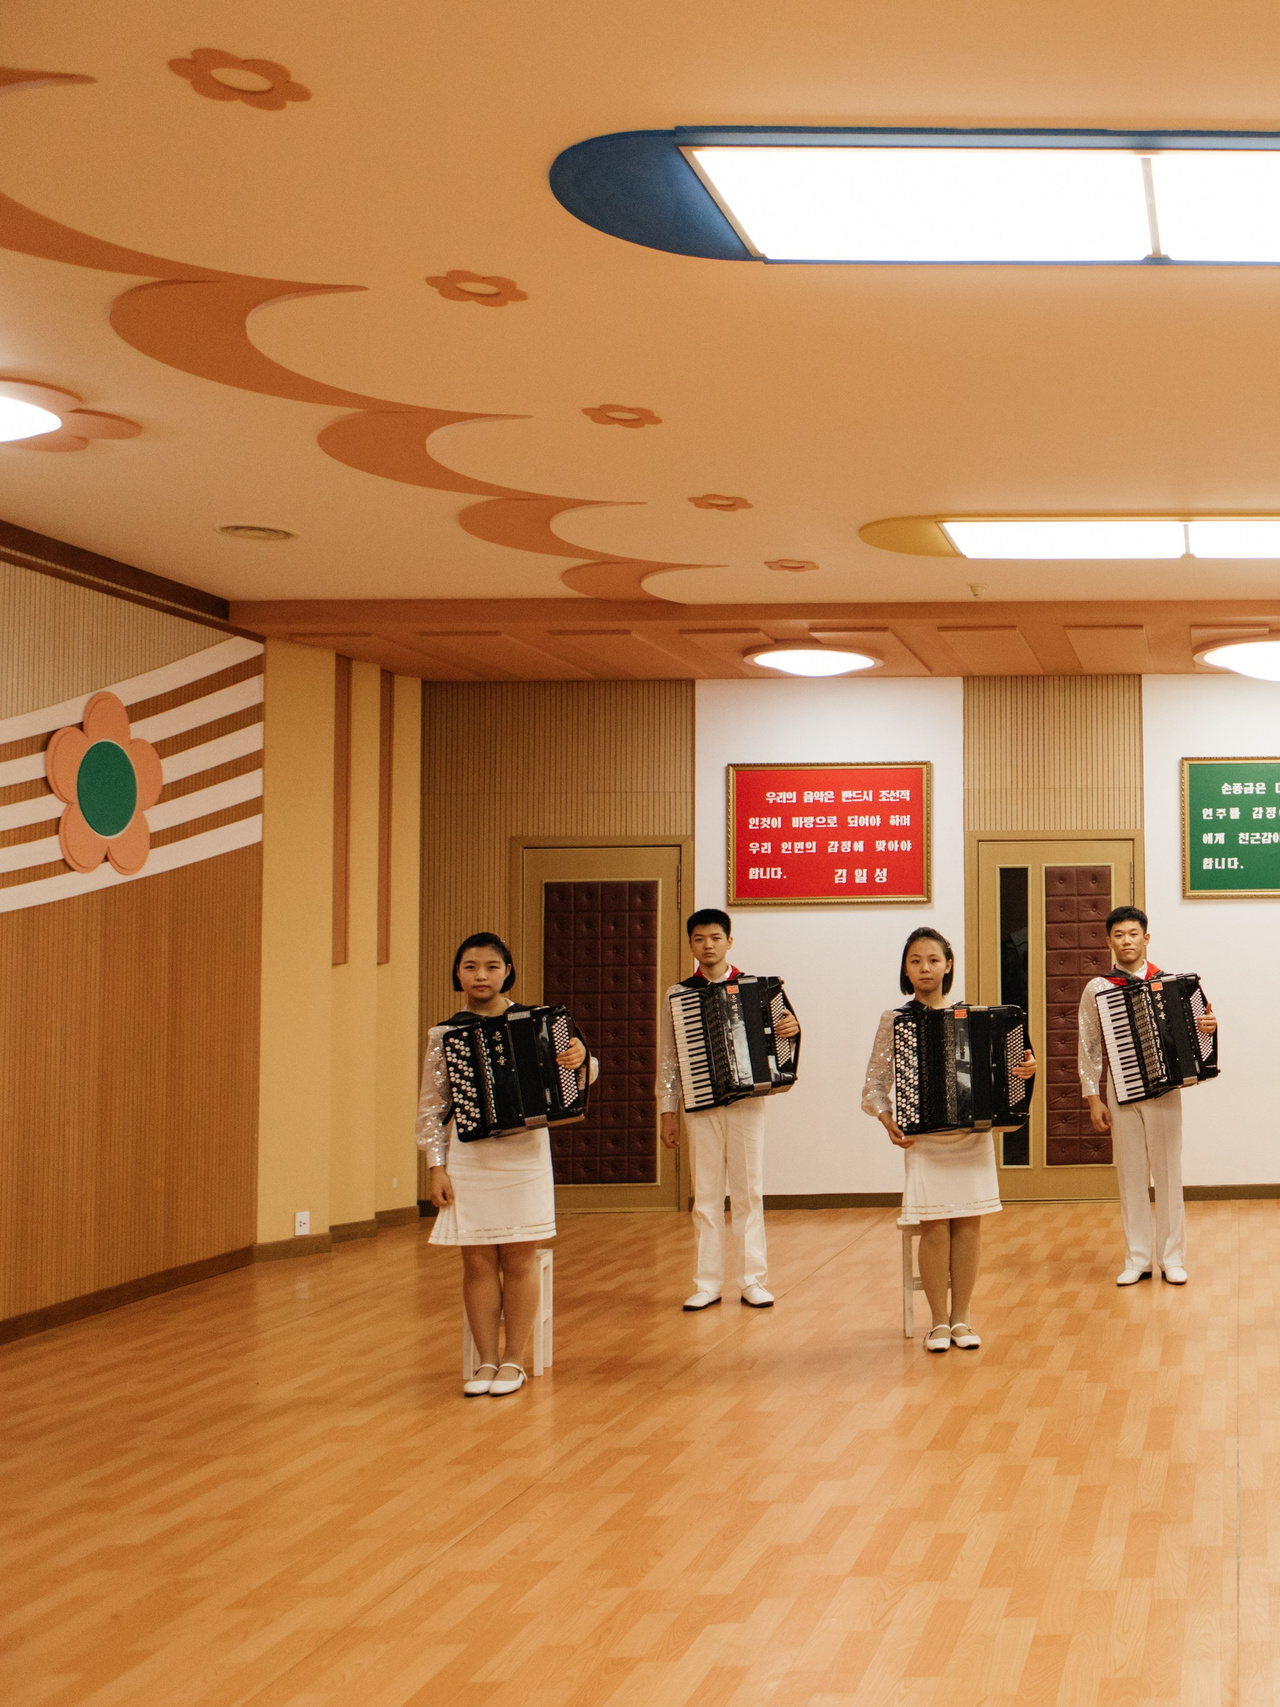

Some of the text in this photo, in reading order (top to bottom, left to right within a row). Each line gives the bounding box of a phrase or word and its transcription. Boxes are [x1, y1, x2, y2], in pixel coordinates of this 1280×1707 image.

[1221, 782, 1267, 796] 손풍금은
[765, 789, 910, 804] 우리의 음악은 반드시 조선적
[1202, 807, 1241, 820] 연주를
[748, 814, 911, 830] 인것이 바탕으로 되여야 하며
[1202, 832, 1225, 845] 에게
[748, 840, 912, 855] 우리 인민의 감정에 맞아야
[1202, 857, 1244, 870] 합니다.
[748, 867, 787, 880] 합니다.
